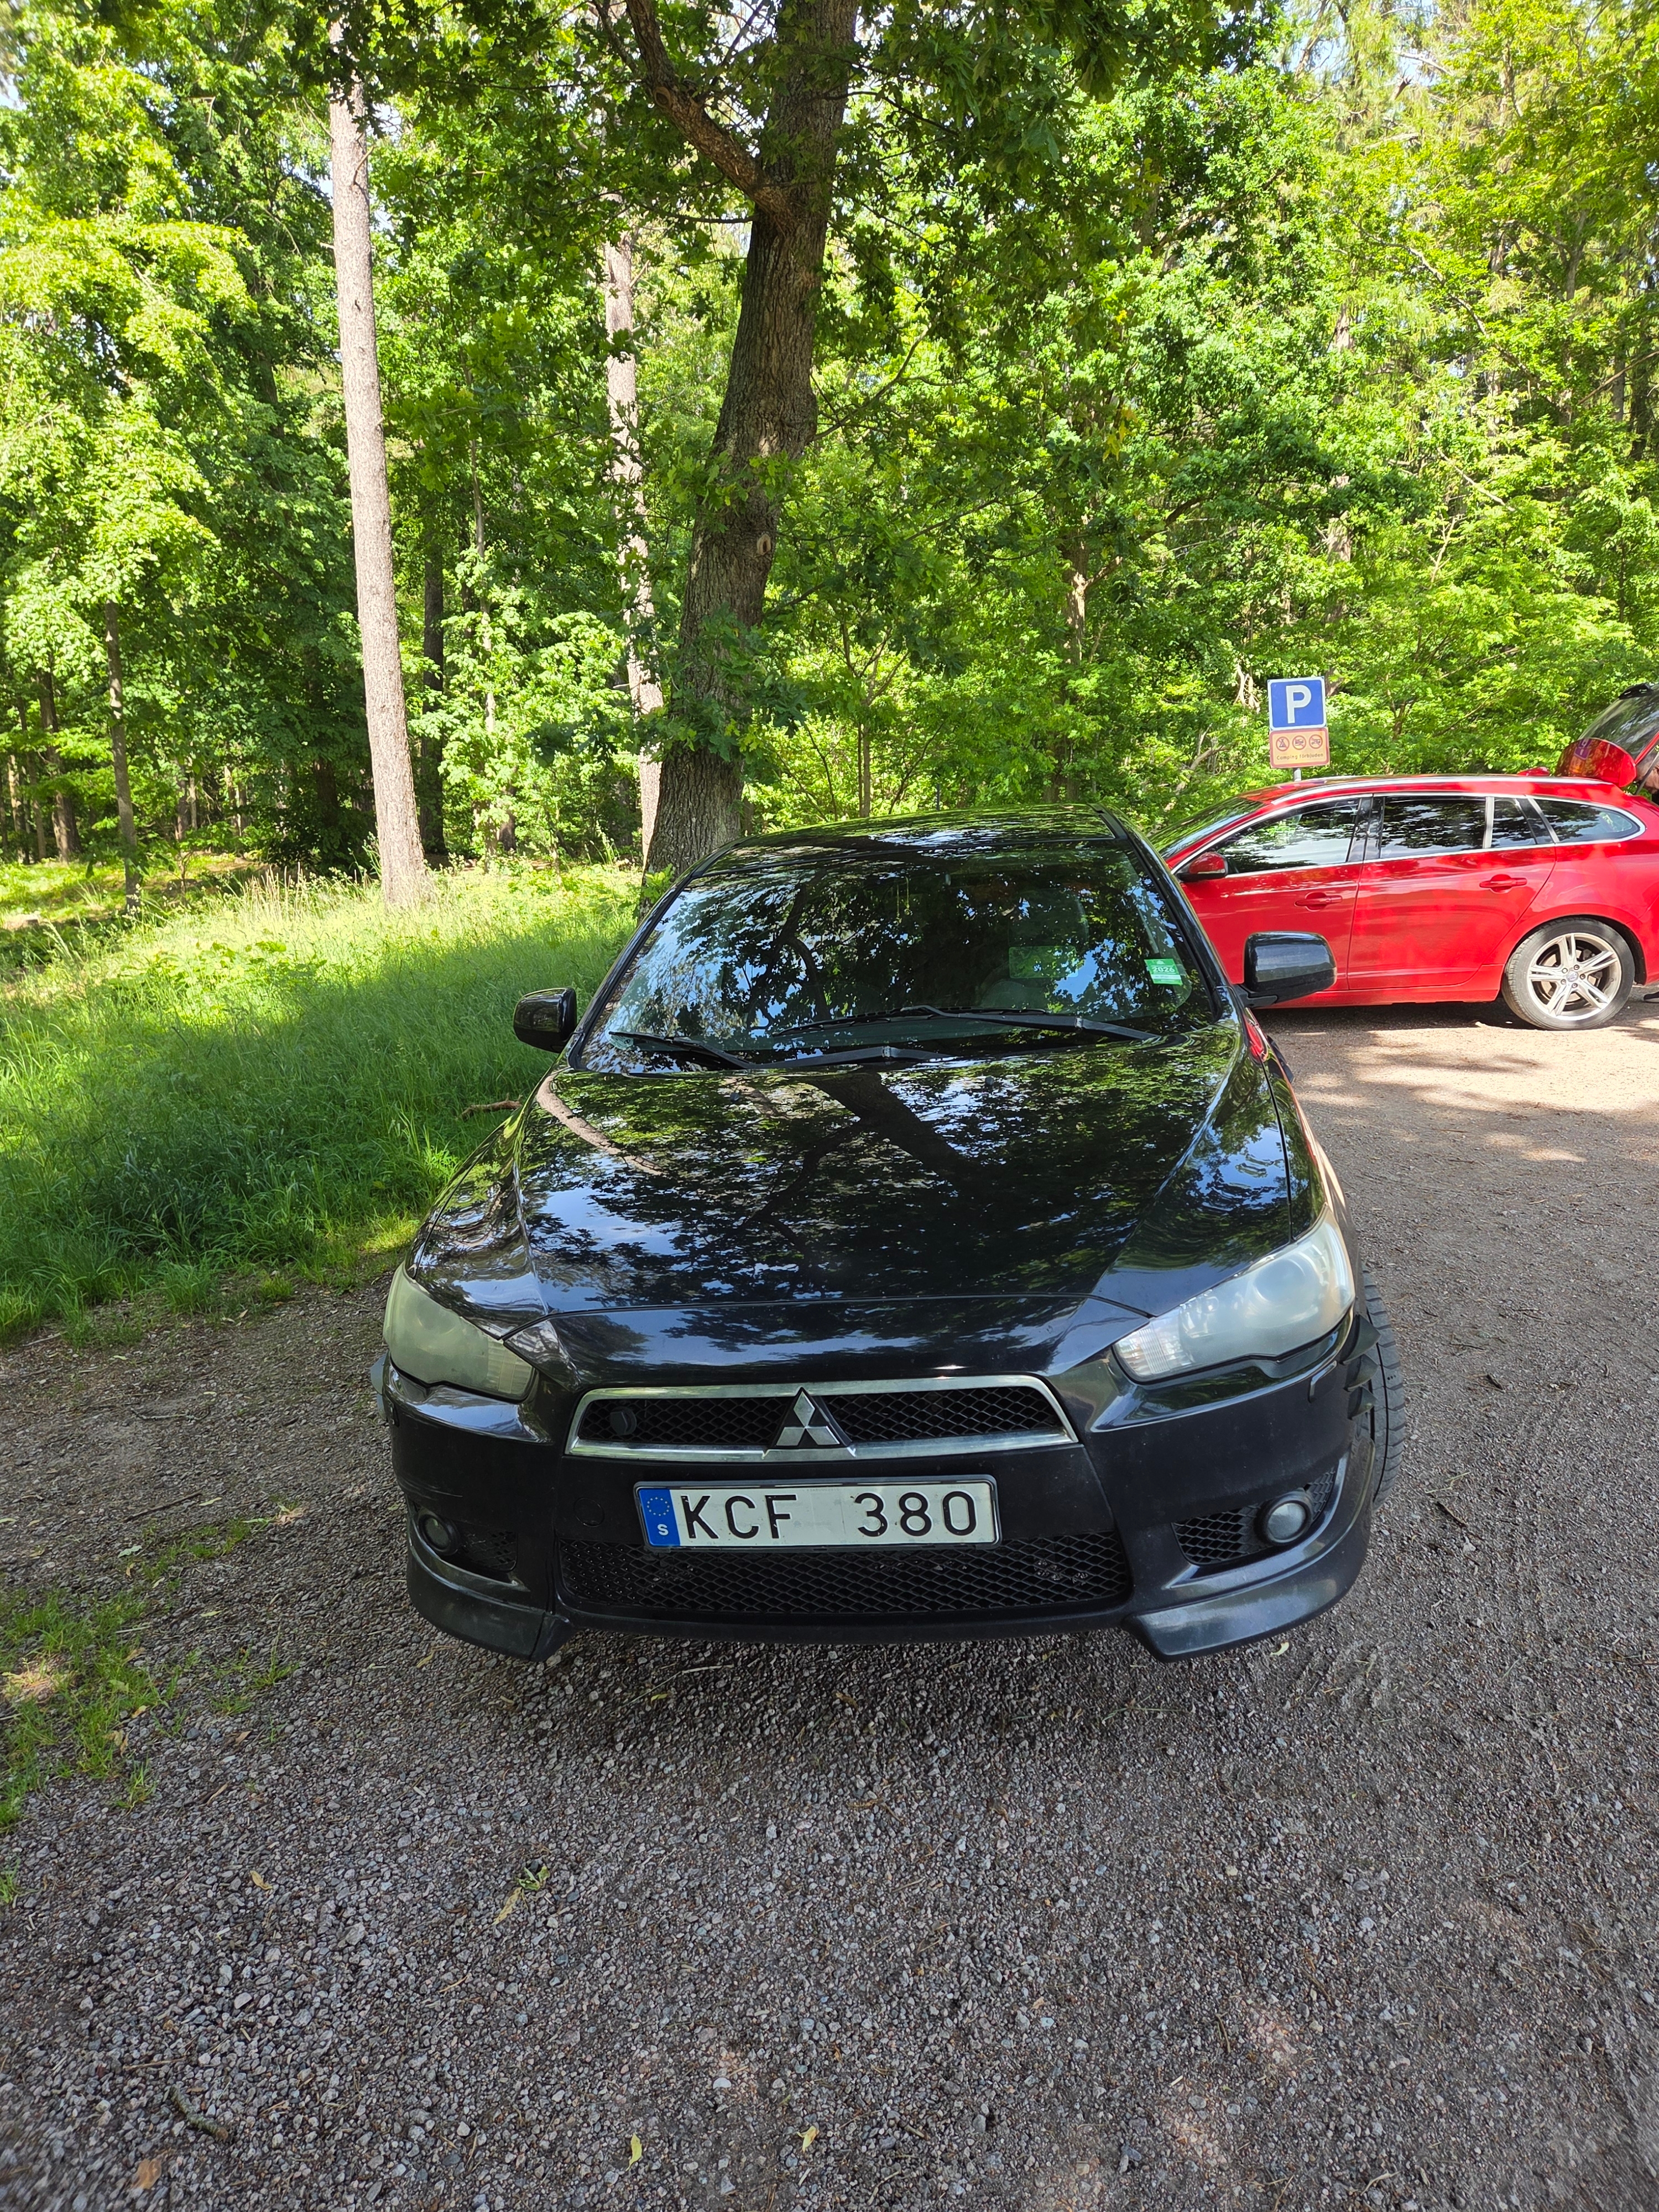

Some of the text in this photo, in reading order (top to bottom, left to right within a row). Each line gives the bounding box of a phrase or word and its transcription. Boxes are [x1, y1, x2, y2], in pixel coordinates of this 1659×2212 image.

[1286, 685, 1312, 724] P
[657, 1524, 669, 1536] S
[680, 1491, 977, 1540] KCF 380
